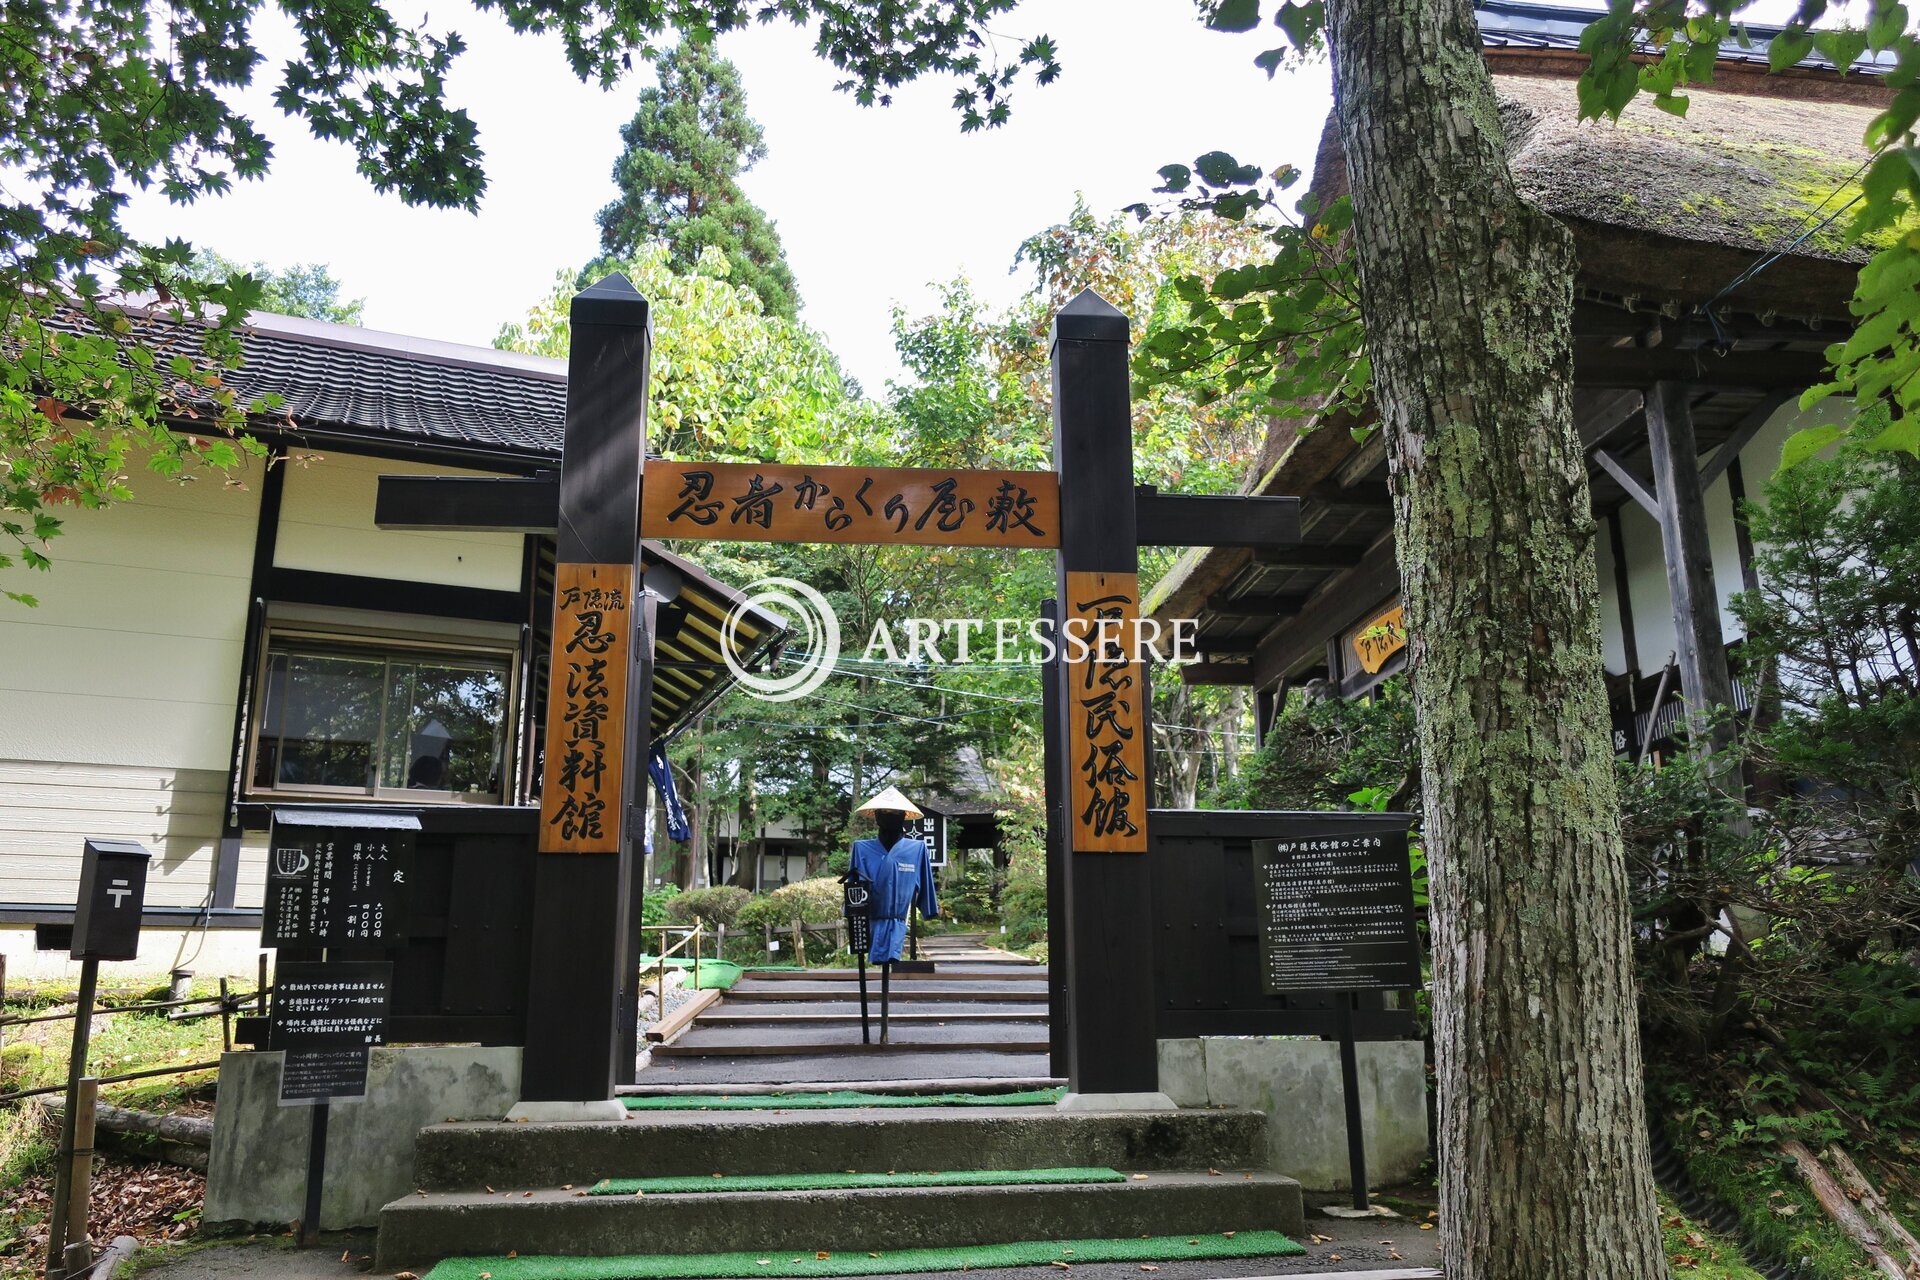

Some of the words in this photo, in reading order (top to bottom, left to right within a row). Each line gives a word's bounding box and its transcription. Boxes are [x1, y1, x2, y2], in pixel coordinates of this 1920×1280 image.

[666, 470, 1046, 538] 忍者からくり屋敷
[560, 586, 625, 611] 戸隠流
[550, 610, 616, 840] 忍法資料館
[323, 842, 335, 880] 営業時間
[352, 843, 362, 861] 団体
[365, 843, 375, 861] 小人
[378, 843, 388, 861] 大人
[392, 870, 405, 883] 定
[347, 904, 358, 938] 一割引
[289, 983, 385, 991] 敷地内での御食事は出来ません
[286, 1024, 373, 1033] ついての責任は負いかねます
